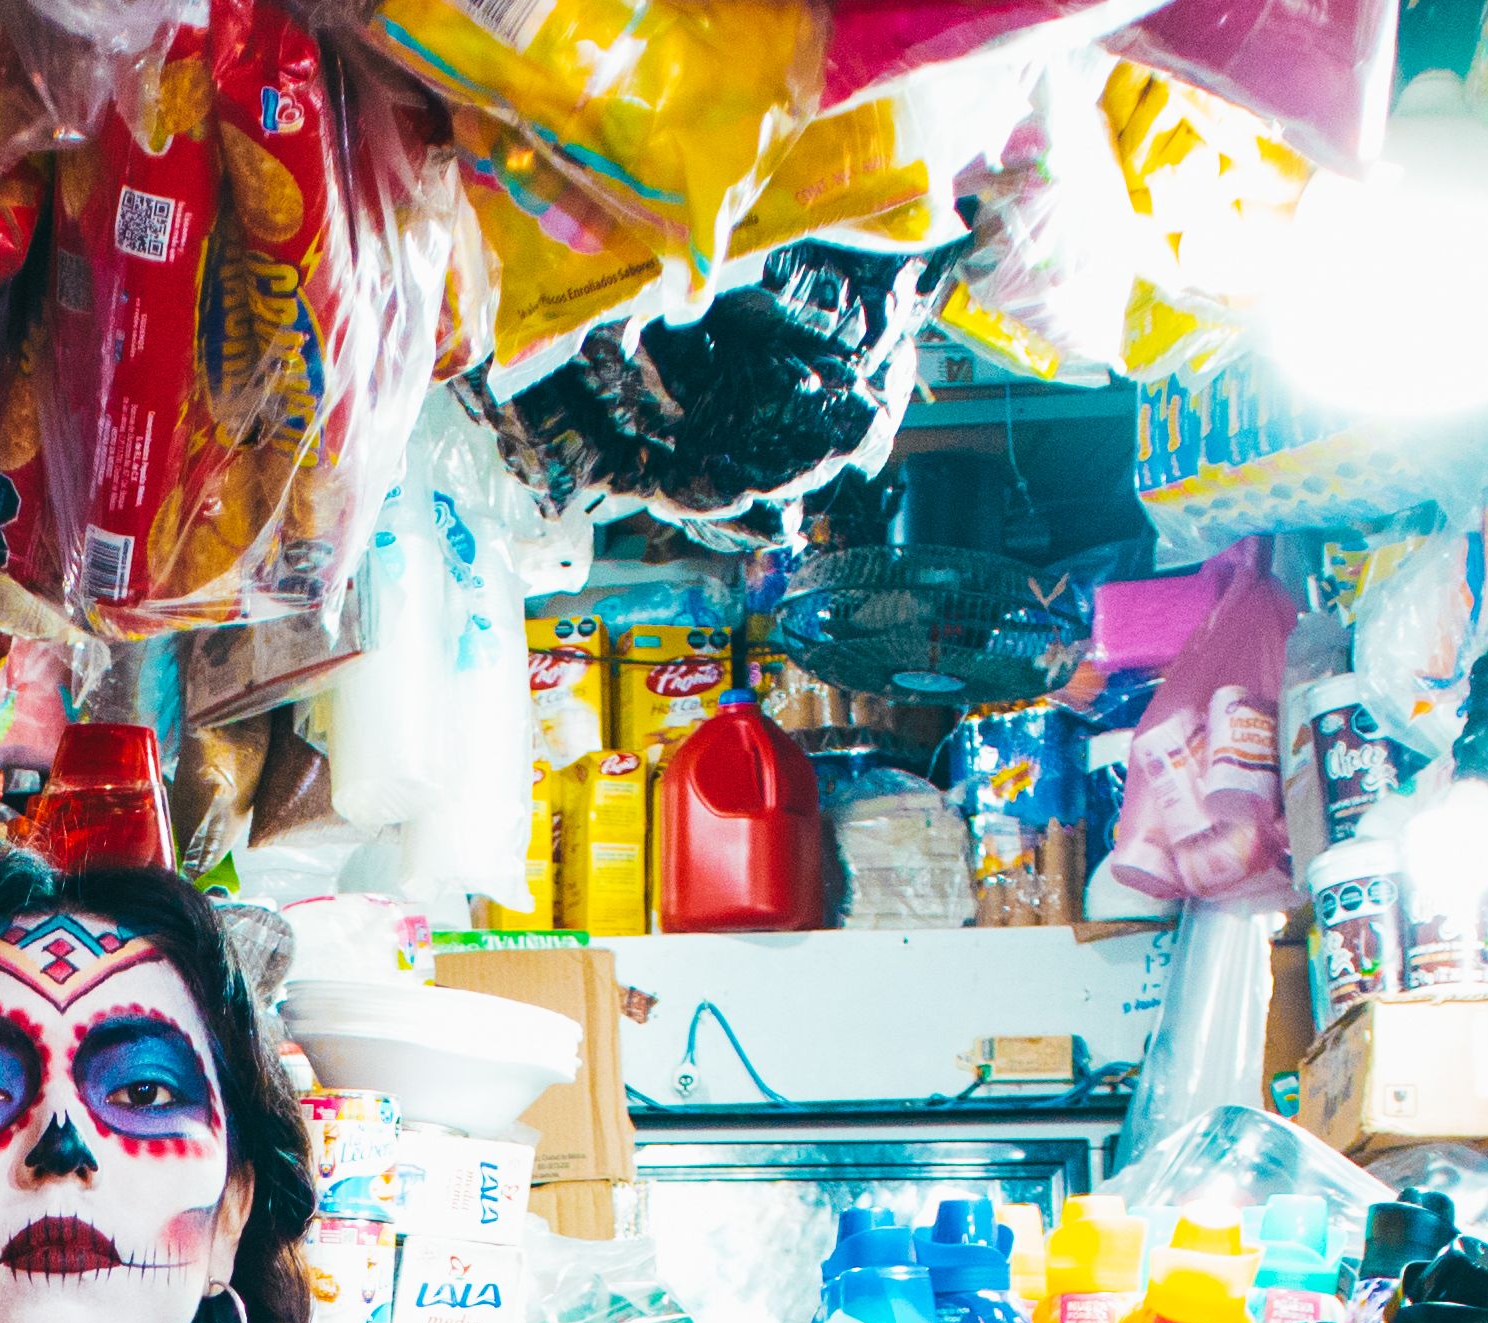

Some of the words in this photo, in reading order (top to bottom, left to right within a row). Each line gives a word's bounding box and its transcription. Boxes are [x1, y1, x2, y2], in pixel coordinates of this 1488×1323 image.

[654, 659, 725, 694] Pronto
[650, 698, 681, 717] Hot
[479, 1161, 499, 1225] LALA
[415, 1281, 502, 1309] LALA
